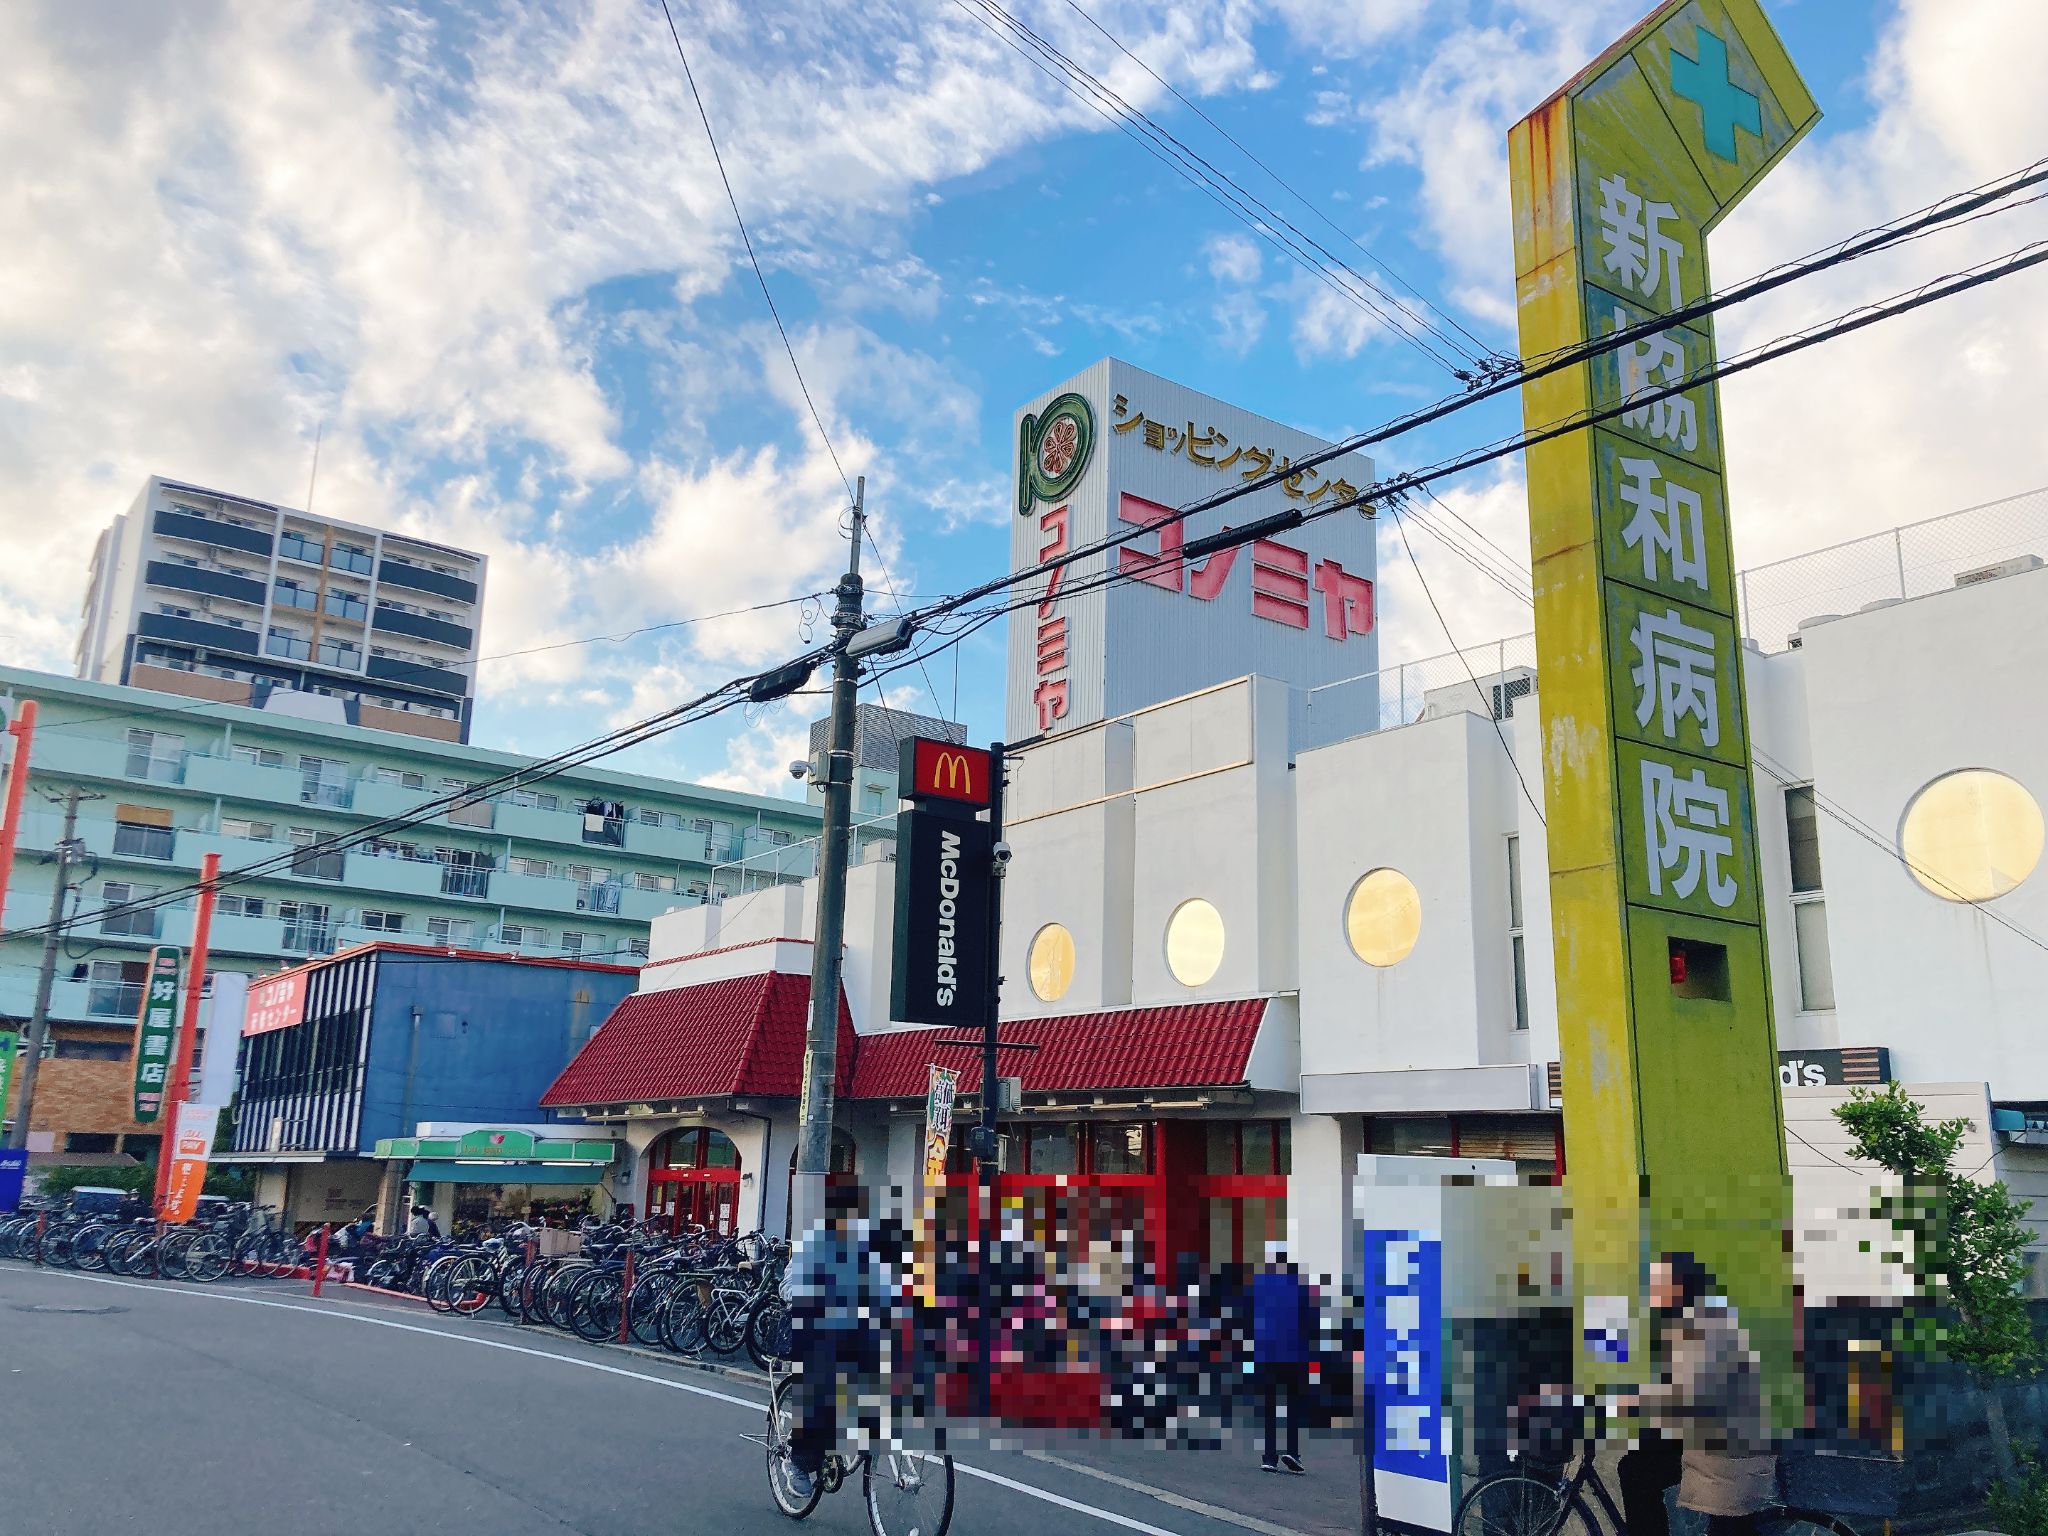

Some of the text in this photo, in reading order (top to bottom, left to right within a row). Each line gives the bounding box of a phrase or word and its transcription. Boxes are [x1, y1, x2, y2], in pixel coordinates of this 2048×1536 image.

[1033, 505, 1072, 730] コノミヤ
[1118, 491, 1374, 641] コノミヤ
[1599, 174, 1738, 909] 新協和病院
[936, 830, 961, 1007] McDonald's
